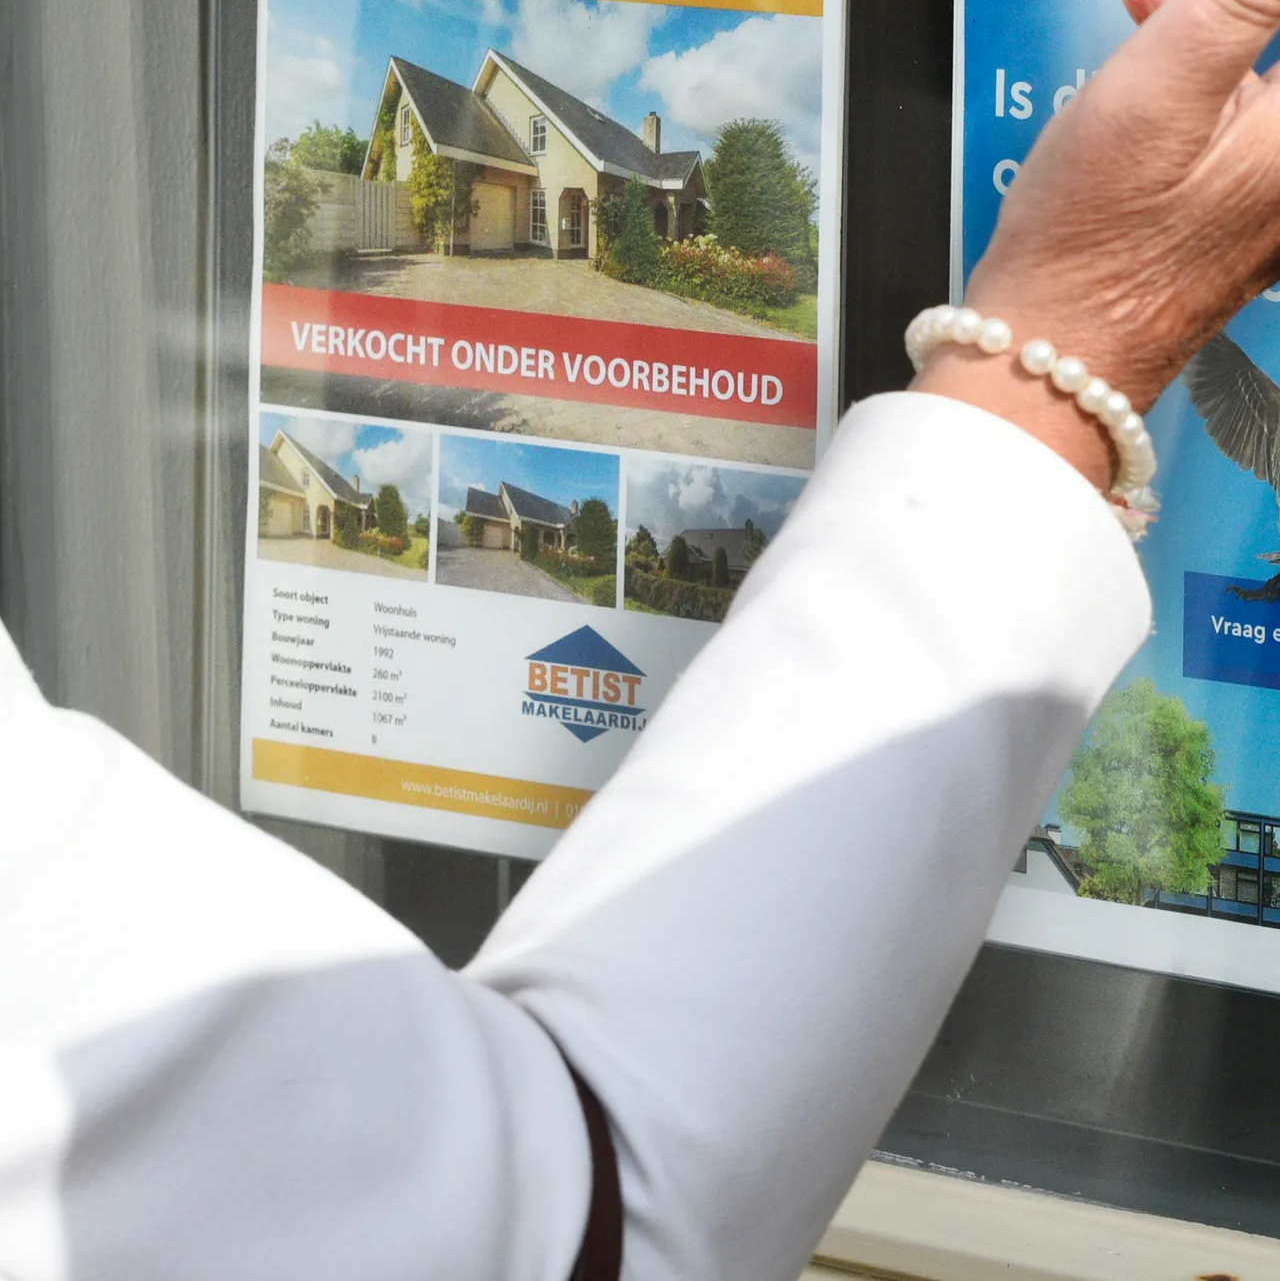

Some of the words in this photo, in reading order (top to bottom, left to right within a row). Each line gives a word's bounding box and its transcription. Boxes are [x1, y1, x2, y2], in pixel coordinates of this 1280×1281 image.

[995, 69, 1033, 120] Is
[291, 321, 445, 367] VERKOCHT
[451, 339, 556, 380] ONDER
[563, 353, 784, 405] VOORBEHOUD
[273, 588, 298, 601] Soort
[300, 591, 328, 604] object
[374, 602, 417, 618] Woonhuis
[272, 609, 293, 622] Type
[296, 615, 330, 628] woning
[374, 624, 420, 640] Vrijstaande
[423, 633, 456, 646] woning
[1211, 615, 1265, 643] Vraag
[272, 631, 314, 647] Bouwjaar
[374, 647, 394, 659] 1992
[271, 653, 352, 674] Woonoppervlakte
[271, 675, 357, 697] Perceeloppervlakte
[528, 662, 641, 705] BETIST
[270, 698, 302, 710] Inhoud
[522, 701, 647, 731] MAKELAARDIJ
[270, 719, 299, 733] Aantal
[301, 724, 333, 737] kamers
[402, 779, 548, 812] www.betistmakelaardij.nl
